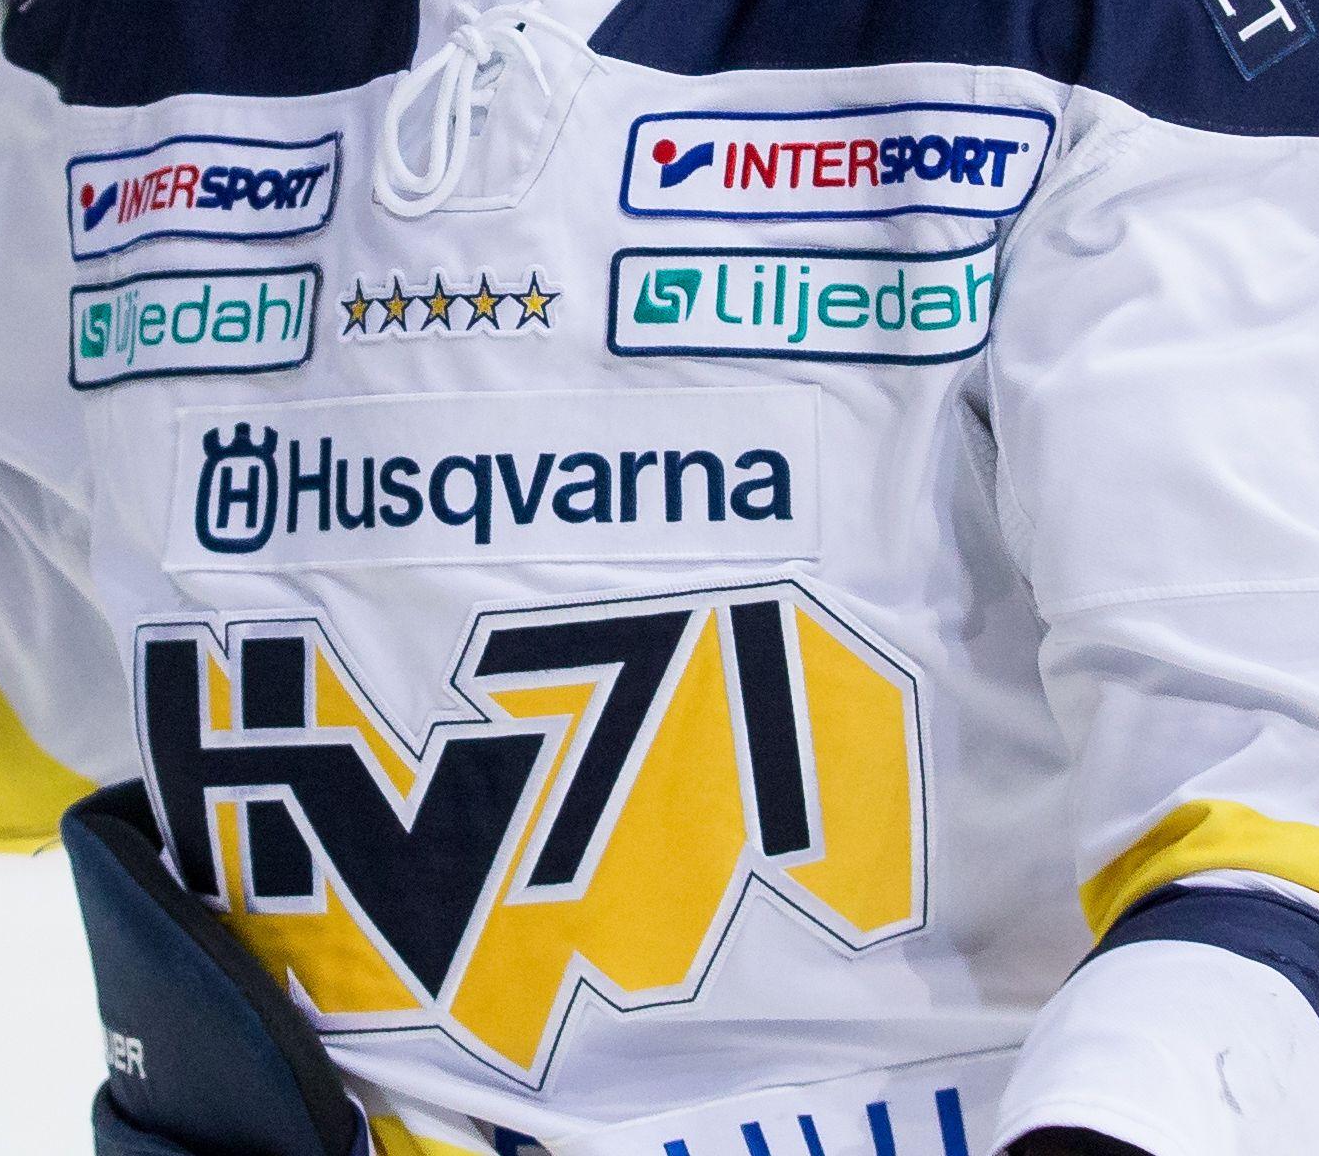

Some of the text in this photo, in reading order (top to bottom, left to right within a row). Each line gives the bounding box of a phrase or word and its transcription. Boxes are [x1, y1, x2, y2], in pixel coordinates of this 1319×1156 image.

[117, 162, 330, 224] INTERSPORT
[724, 134, 1019, 188] INTERSPORT
[115, 278, 305, 366] Liljedahl
[716, 263, 994, 343] Liljedah
[287, 437, 794, 544] Husqvarna
[145, 600, 810, 1002] HV71
